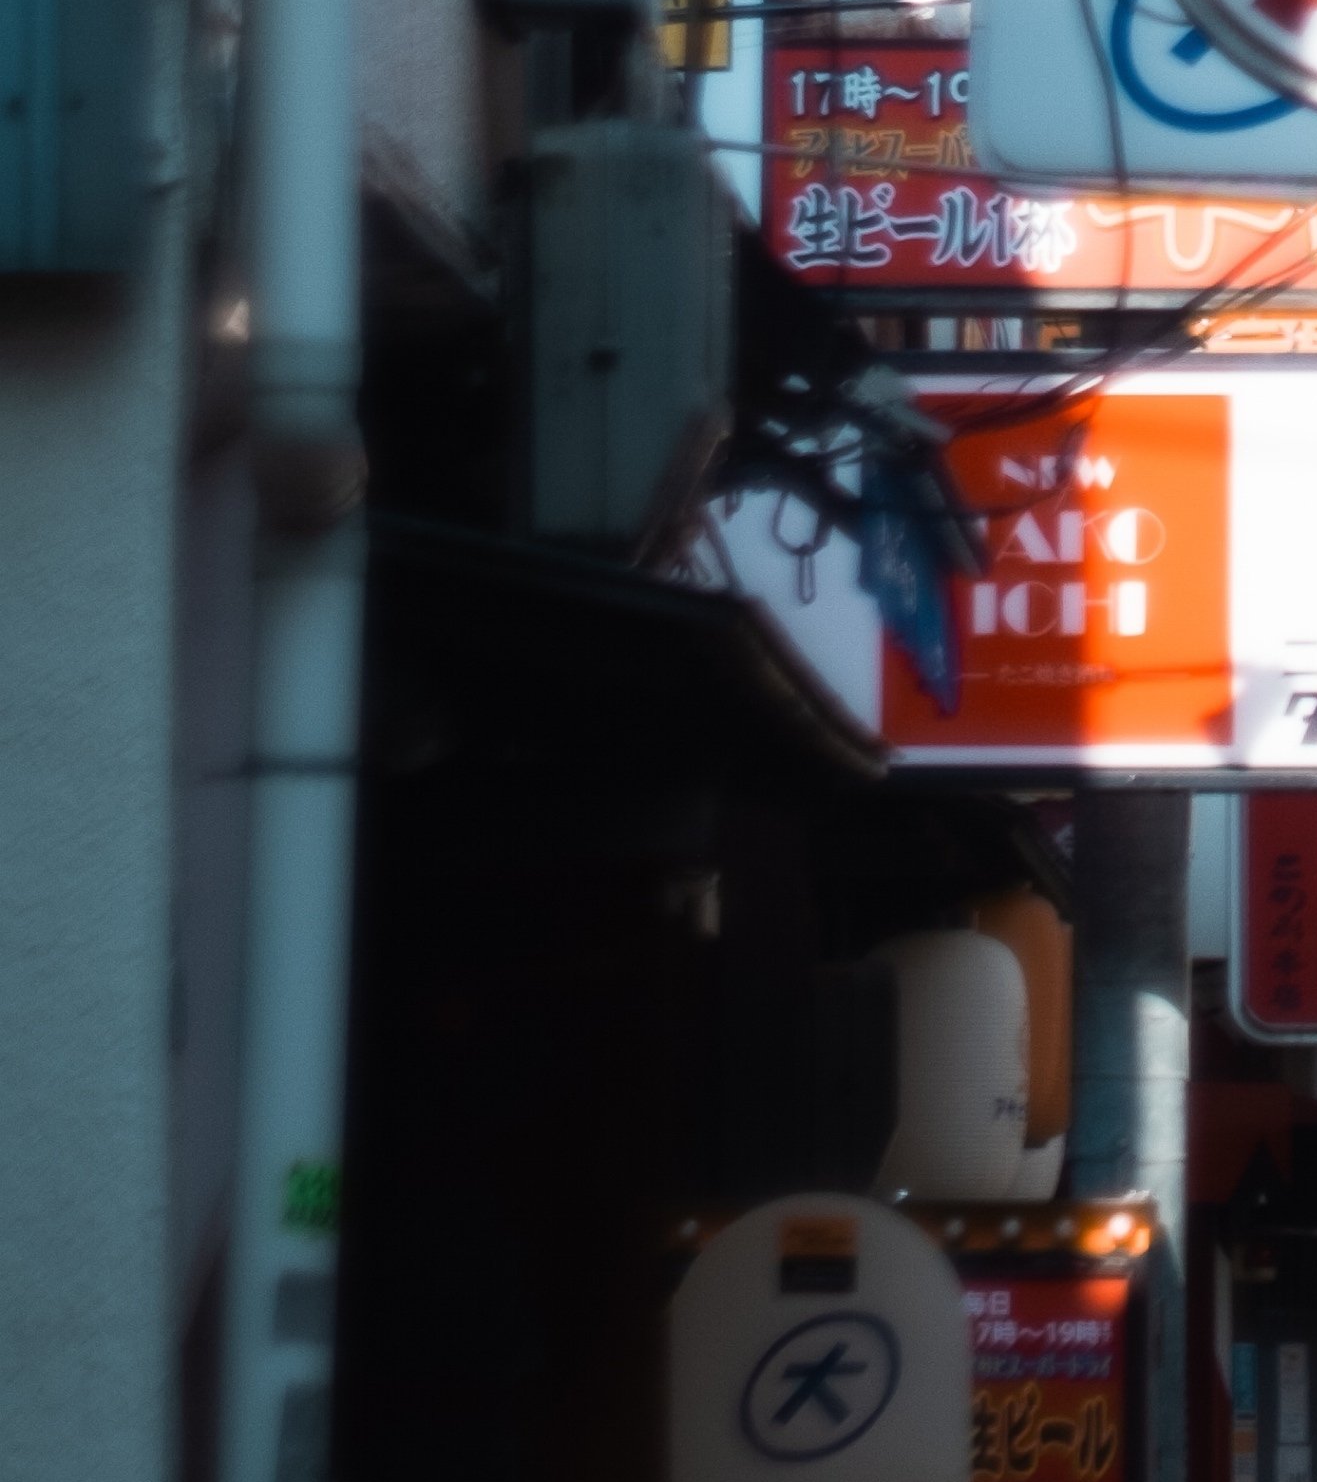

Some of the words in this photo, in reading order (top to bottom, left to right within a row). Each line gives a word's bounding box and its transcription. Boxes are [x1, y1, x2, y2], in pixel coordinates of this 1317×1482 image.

[787, 183, 1077, 274] 生ビール1杯
[1000, 454, 1117, 491] NEW
[978, 506, 1168, 565] AKO
[973, 580, 1148, 637] ICHI
